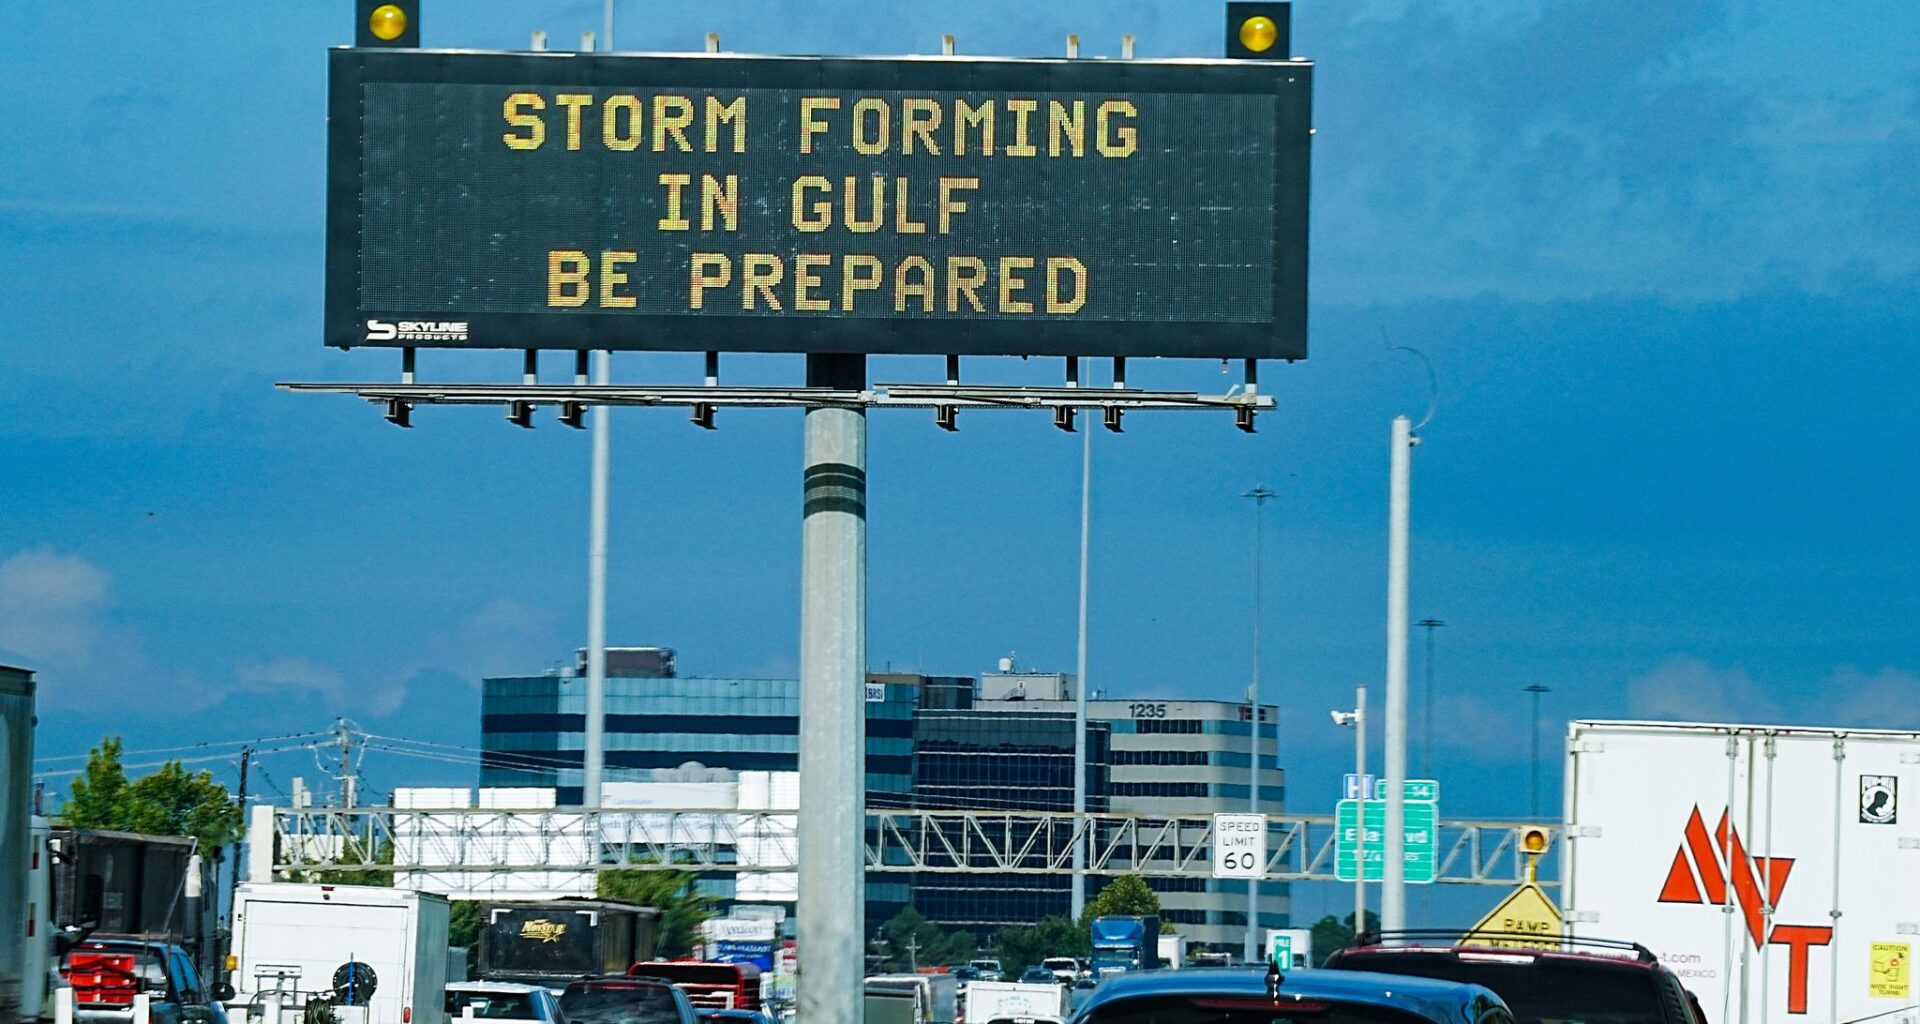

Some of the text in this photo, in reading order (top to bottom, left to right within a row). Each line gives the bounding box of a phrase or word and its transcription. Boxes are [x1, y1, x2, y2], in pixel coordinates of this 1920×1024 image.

[502, 93, 1138, 158] STORM FORMING
[658, 173, 980, 234] IN GULF
[547, 250, 1088, 314] BE PREPARED
[397, 321, 468, 332] SKYLINE
[397, 333, 468, 341] PRODUCTS
[1128, 703, 1167, 719] 1235
[1219, 821, 1259, 832] SPEED
[1222, 836, 1256, 847] LIMIT
[1224, 851, 1255, 870] 60
[1871, 944, 1908, 952] CAUTION
[1278, 950, 1288, 969] 1
[1677, 969, 1716, 979] MEXICO
